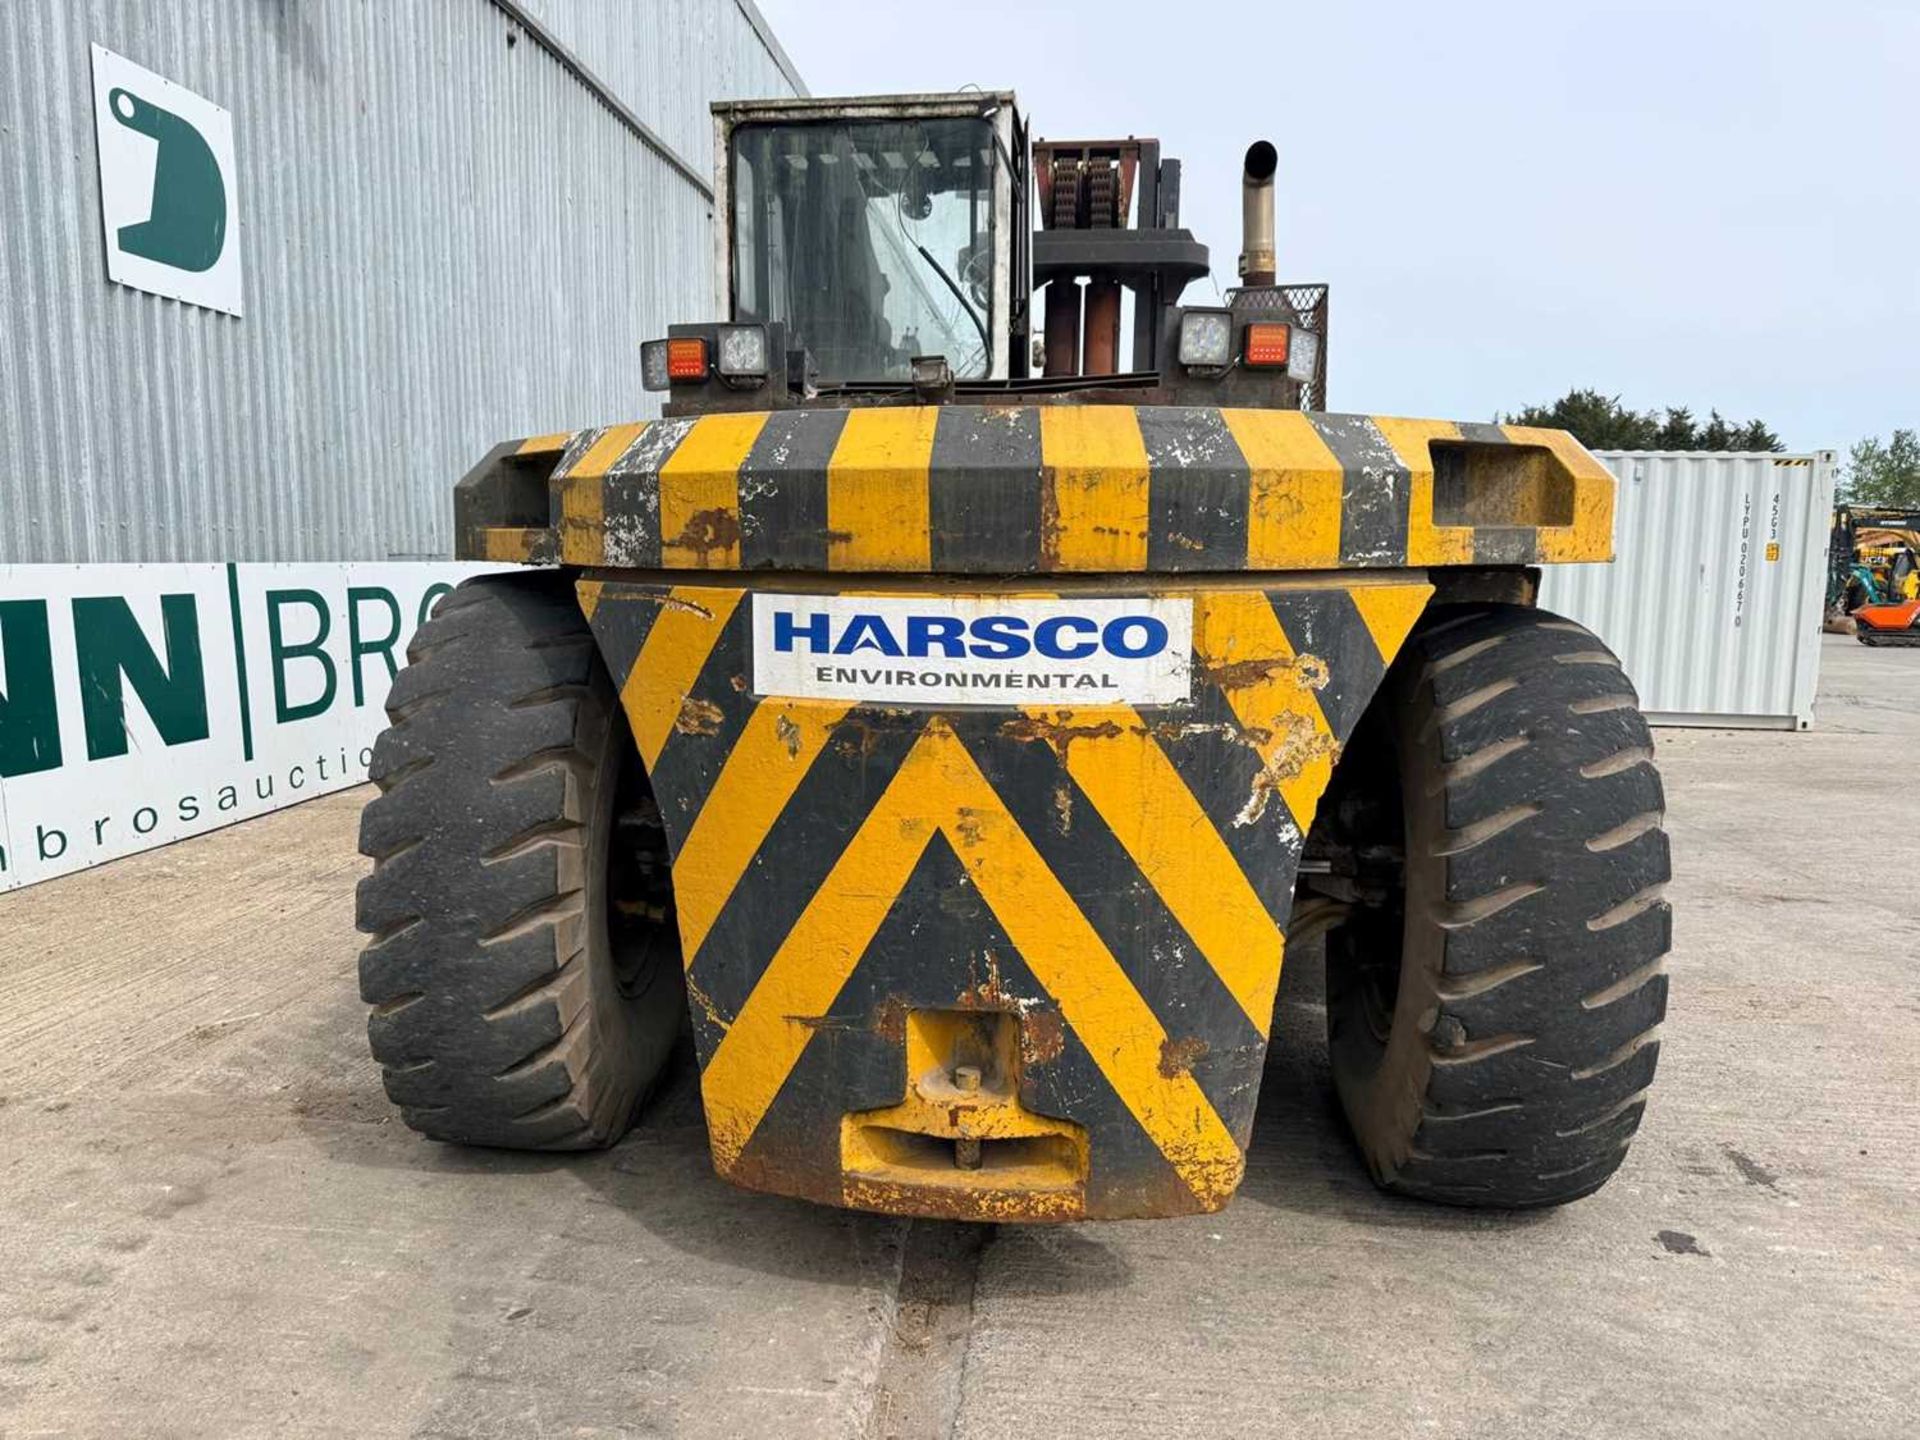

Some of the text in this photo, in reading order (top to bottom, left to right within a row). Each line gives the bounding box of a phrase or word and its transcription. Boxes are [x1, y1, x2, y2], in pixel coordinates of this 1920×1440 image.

[265, 582, 457, 724] BR
[773, 611, 1169, 660] HARSCO
[816, 666, 1119, 689] ENVIRONMENTAL
